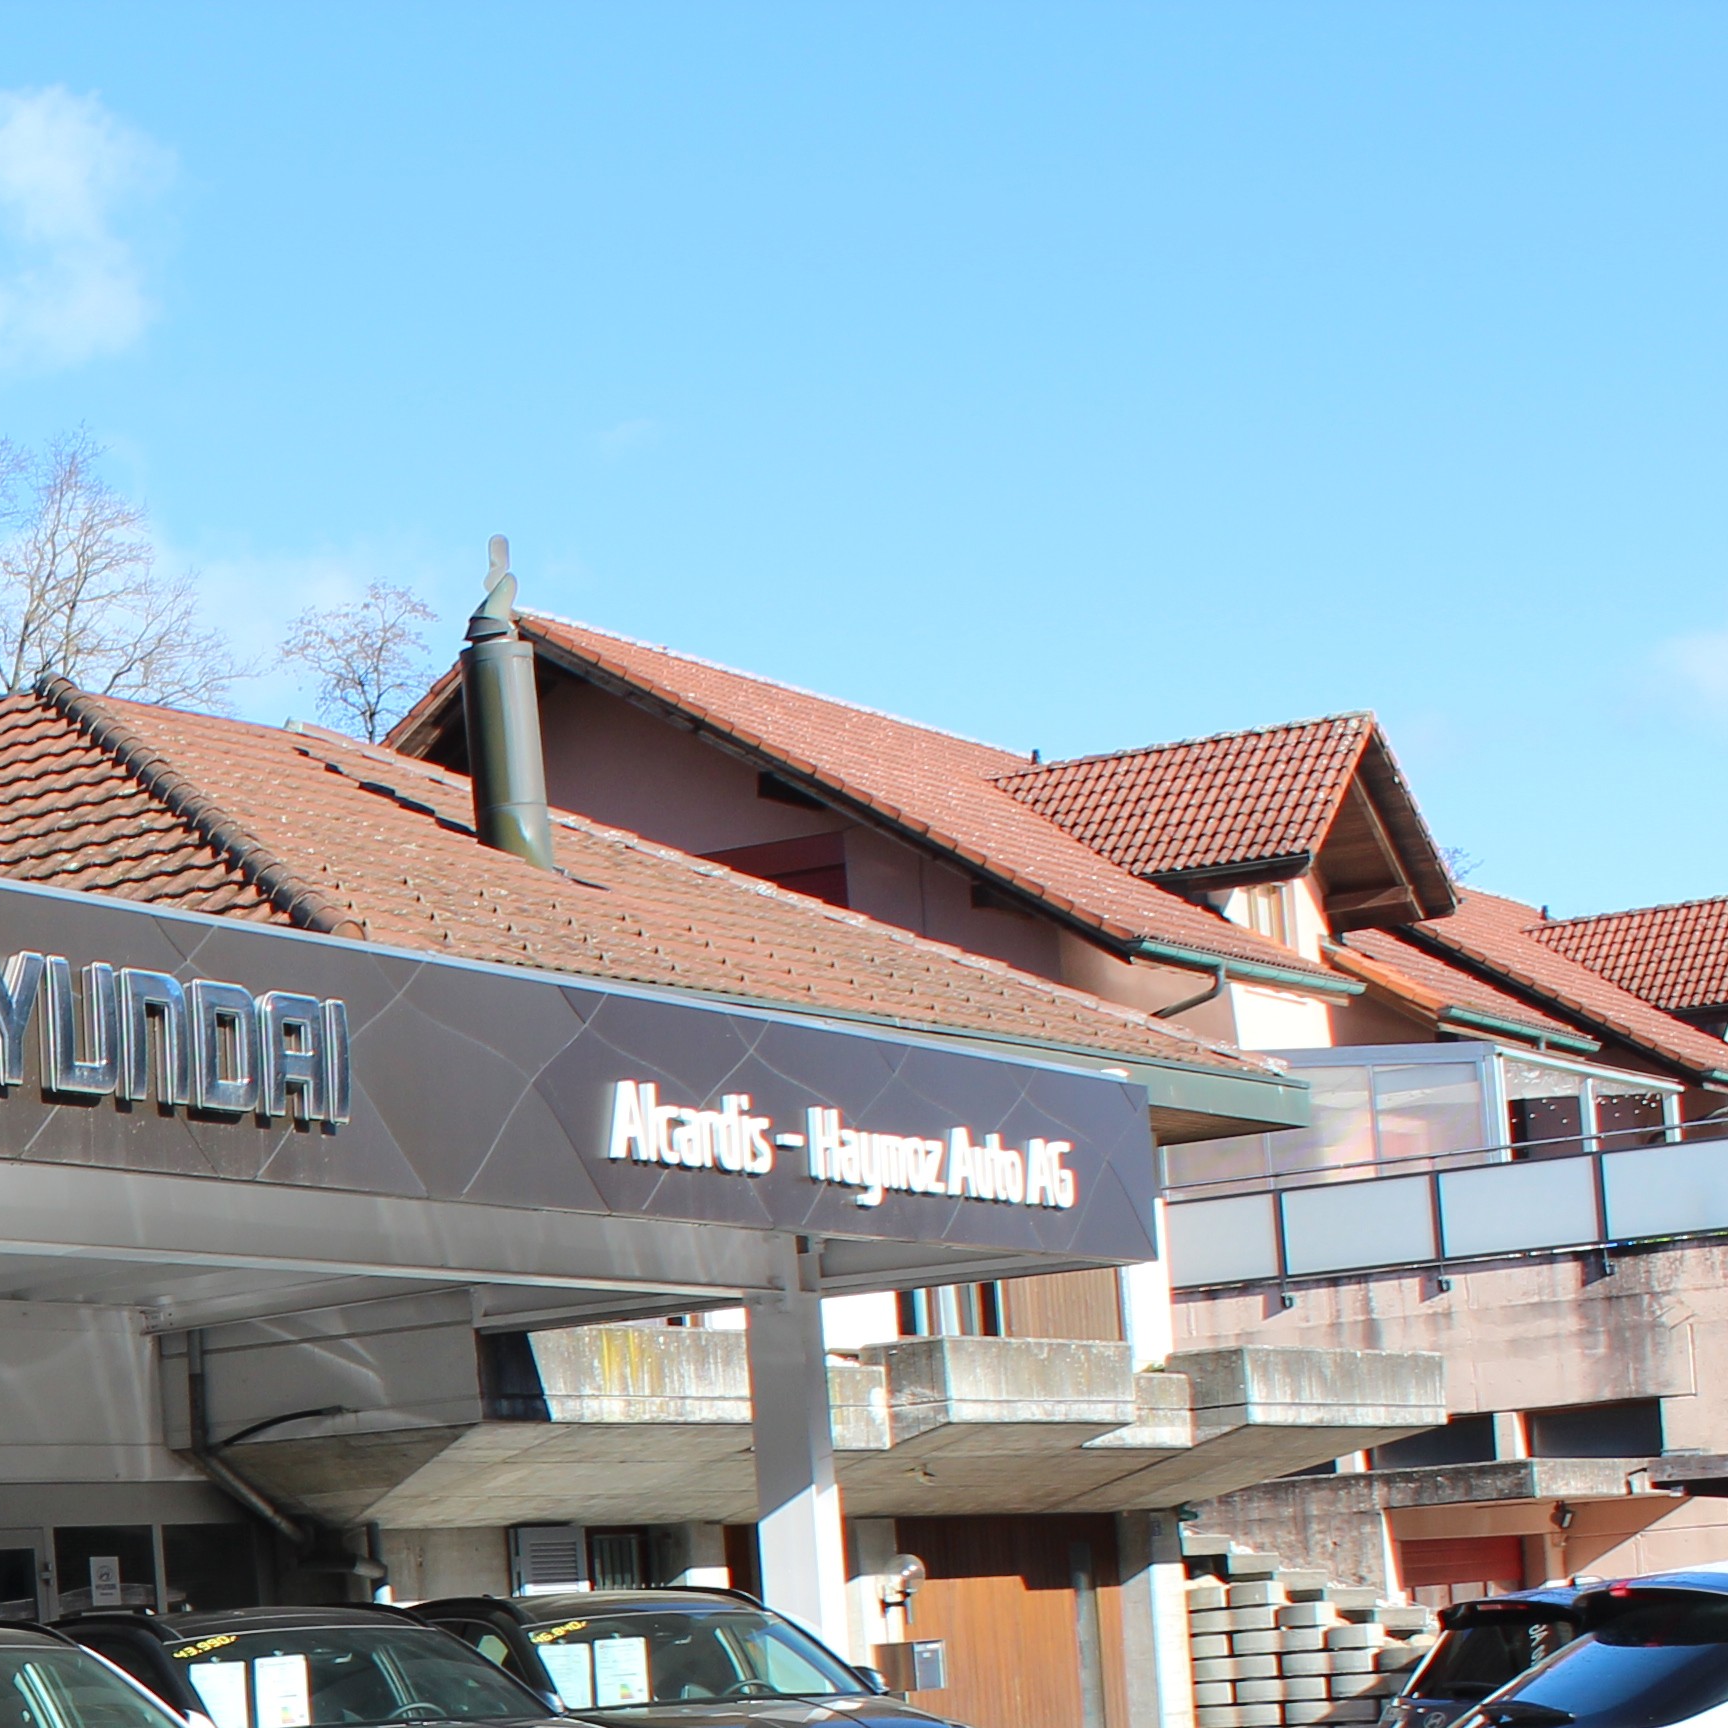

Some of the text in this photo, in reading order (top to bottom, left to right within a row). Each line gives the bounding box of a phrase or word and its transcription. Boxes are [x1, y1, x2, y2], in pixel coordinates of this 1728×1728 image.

[607, 1078, 776, 1178] Alcardis
[807, 1106, 946, 1207] Haymoz
[946, 1125, 1025, 1204] Auto
[1025, 1137, 1076, 1209] AG
